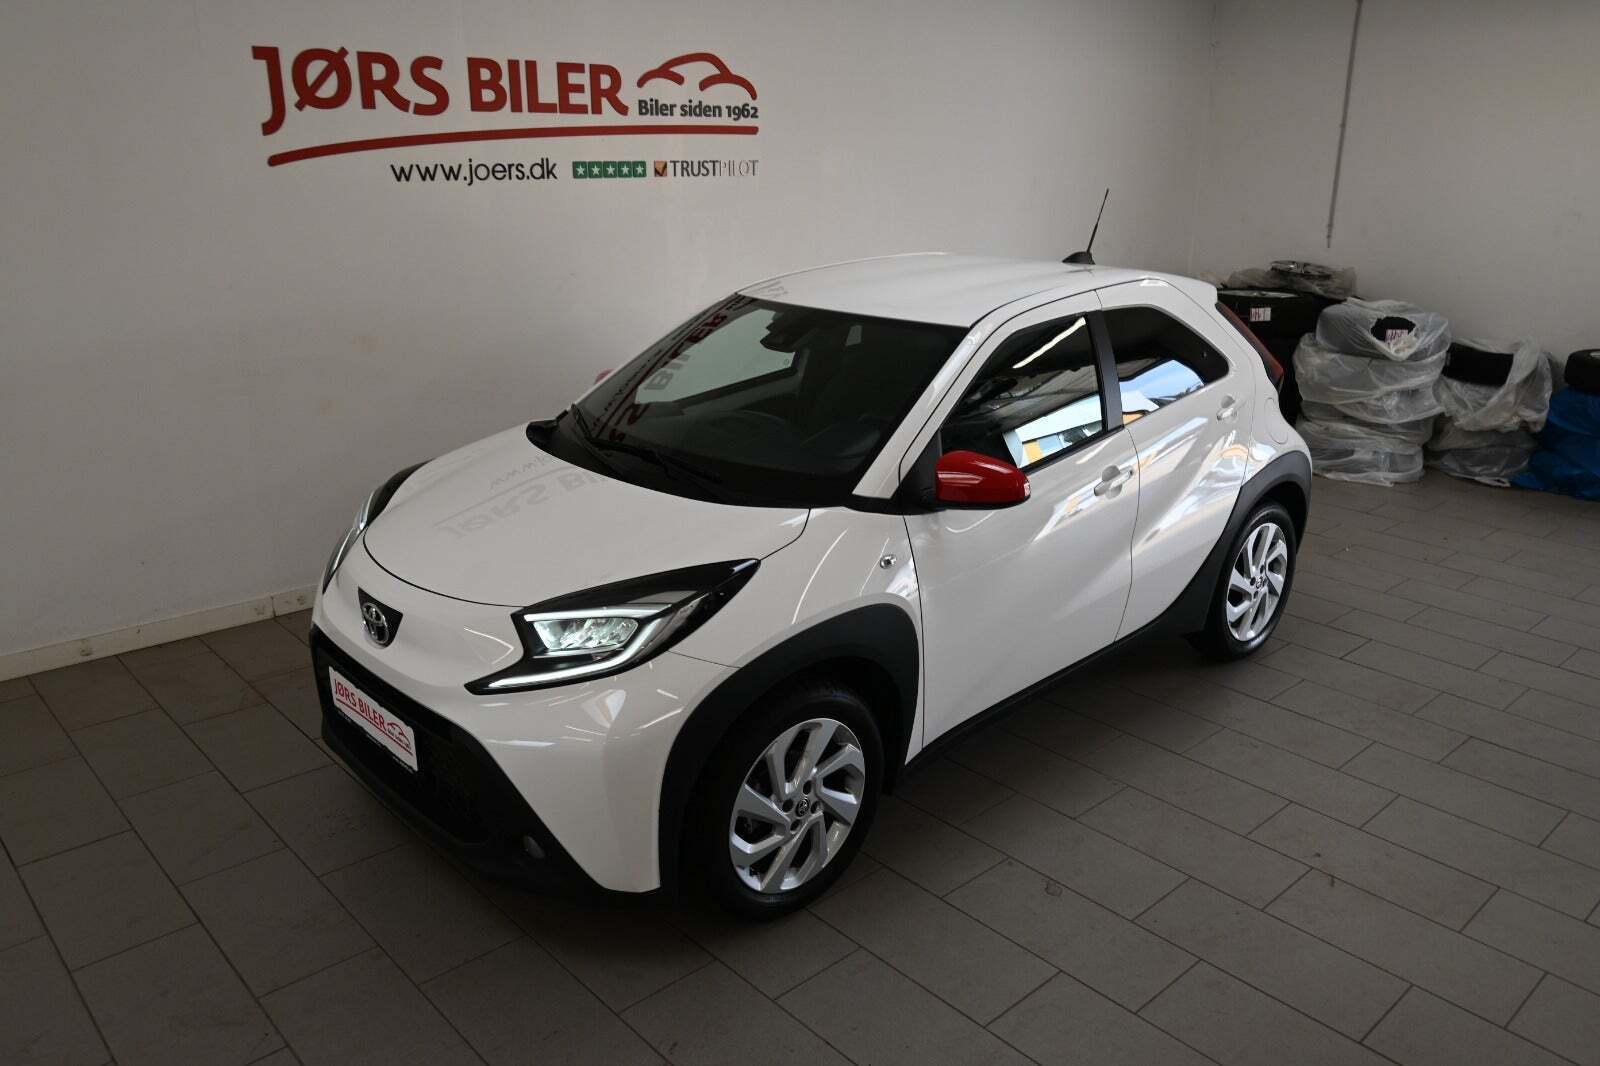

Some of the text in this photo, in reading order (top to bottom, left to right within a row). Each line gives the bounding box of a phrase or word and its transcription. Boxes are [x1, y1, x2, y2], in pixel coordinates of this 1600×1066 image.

[251, 45, 629, 136] JØRS BILER
[637, 97, 759, 121] Biler siden 1962
[390, 157, 558, 186] www.joers.dk
[669, 159, 760, 177] TRUSTPILOT
[357, 697, 387, 732] BILER
